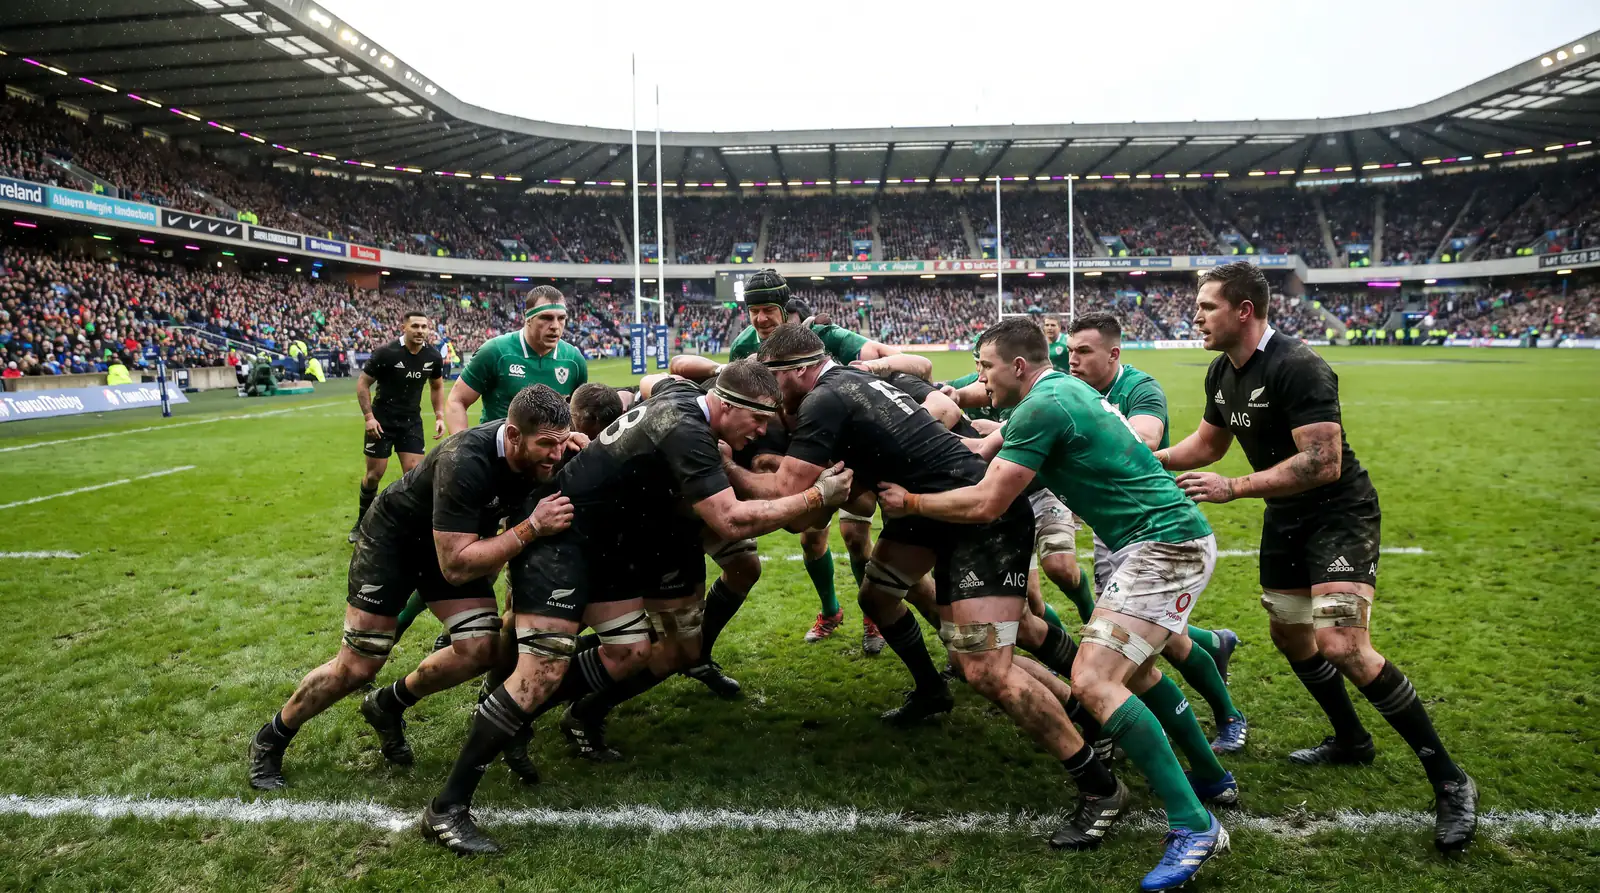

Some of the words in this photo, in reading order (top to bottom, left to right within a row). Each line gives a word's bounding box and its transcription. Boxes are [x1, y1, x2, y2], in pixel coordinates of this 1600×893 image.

[405, 371, 422, 379] AIG
[600, 405, 647, 445] 8
[1230, 412, 1251, 427] AIG
[1003, 572, 1025, 587] AIG
